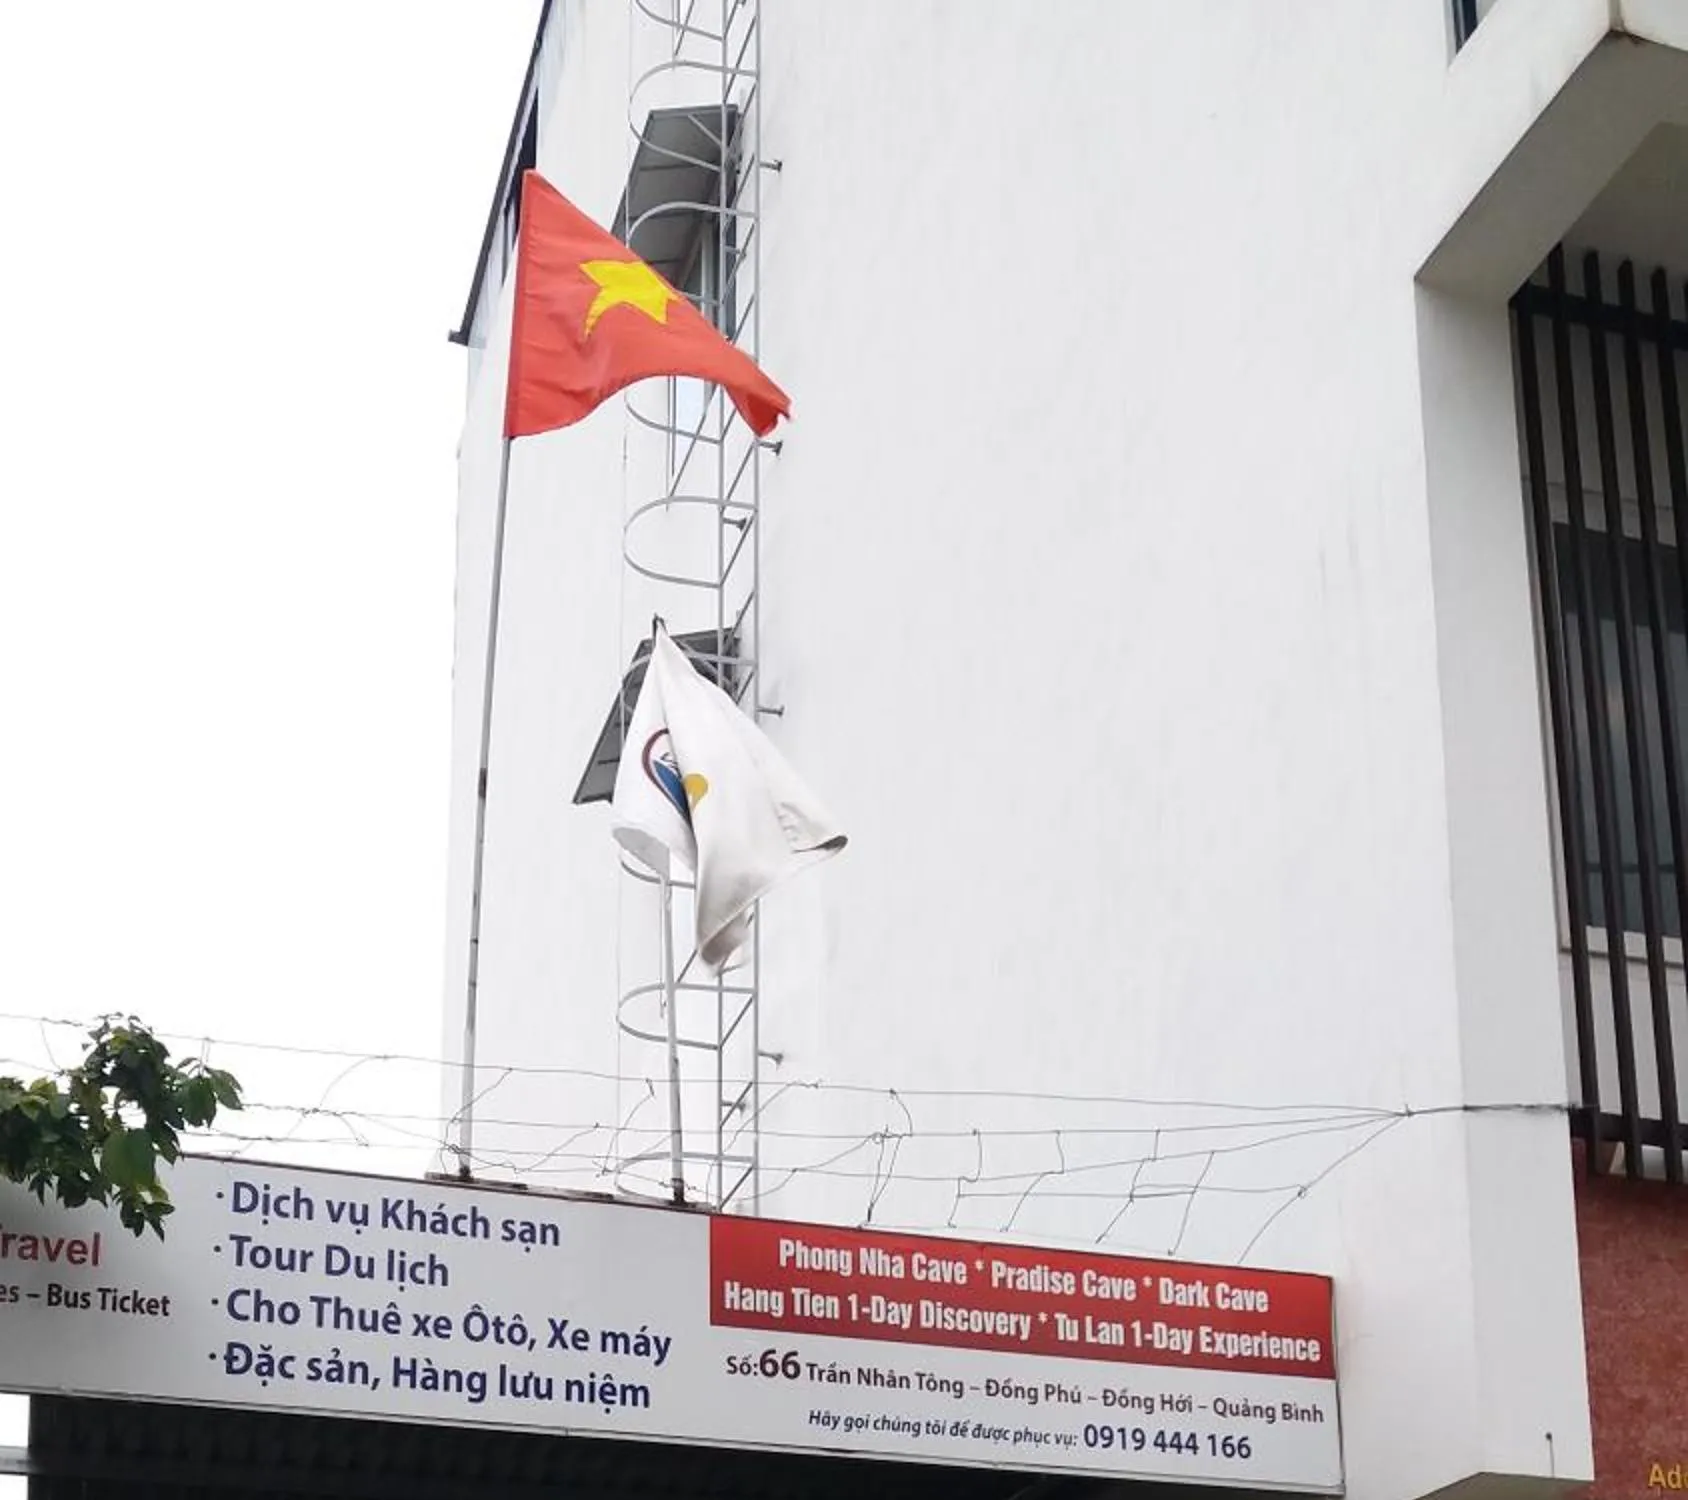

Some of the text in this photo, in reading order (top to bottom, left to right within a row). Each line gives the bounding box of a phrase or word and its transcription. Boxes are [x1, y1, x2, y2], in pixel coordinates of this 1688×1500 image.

[0, 1231, 101, 1267] ravel
[232, 1181, 560, 1253] Dịch vụ Khách sạn
[229, 1234, 449, 1293] Tour Du lịch
[779, 1239, 1269, 1313] Phong Nha Cave Pradise Cave Dark Cave
[47, 1283, 91, 1310] Bus
[97, 1287, 170, 1317] Ticket
[226, 1288, 672, 1366] Cho Thuê xe Ôtô, Xe máy
[724, 1281, 1321, 1362] Hang Tien 1-Day Discovery Tu Lan 1-Day Experience
[223, 1341, 650, 1414] Đặc sản, Hàng lưu niệm
[857, 1367, 911, 1389] Nhân
[914, 1372, 964, 1399] Tông
[1044, 1383, 1082, 1404] Phú
[1213, 1397, 1276, 1424] Quảng
[1282, 1399, 1325, 1423] Bình
[844, 1413, 869, 1434] gọi
[873, 1414, 921, 1438] chúng
[971, 1421, 1009, 1445] được
[1013, 1428, 1050, 1449] phục
[1083, 1424, 1146, 1451] 0919
[1153, 1430, 1199, 1455] 444
[1208, 1434, 1251, 1459] 166
